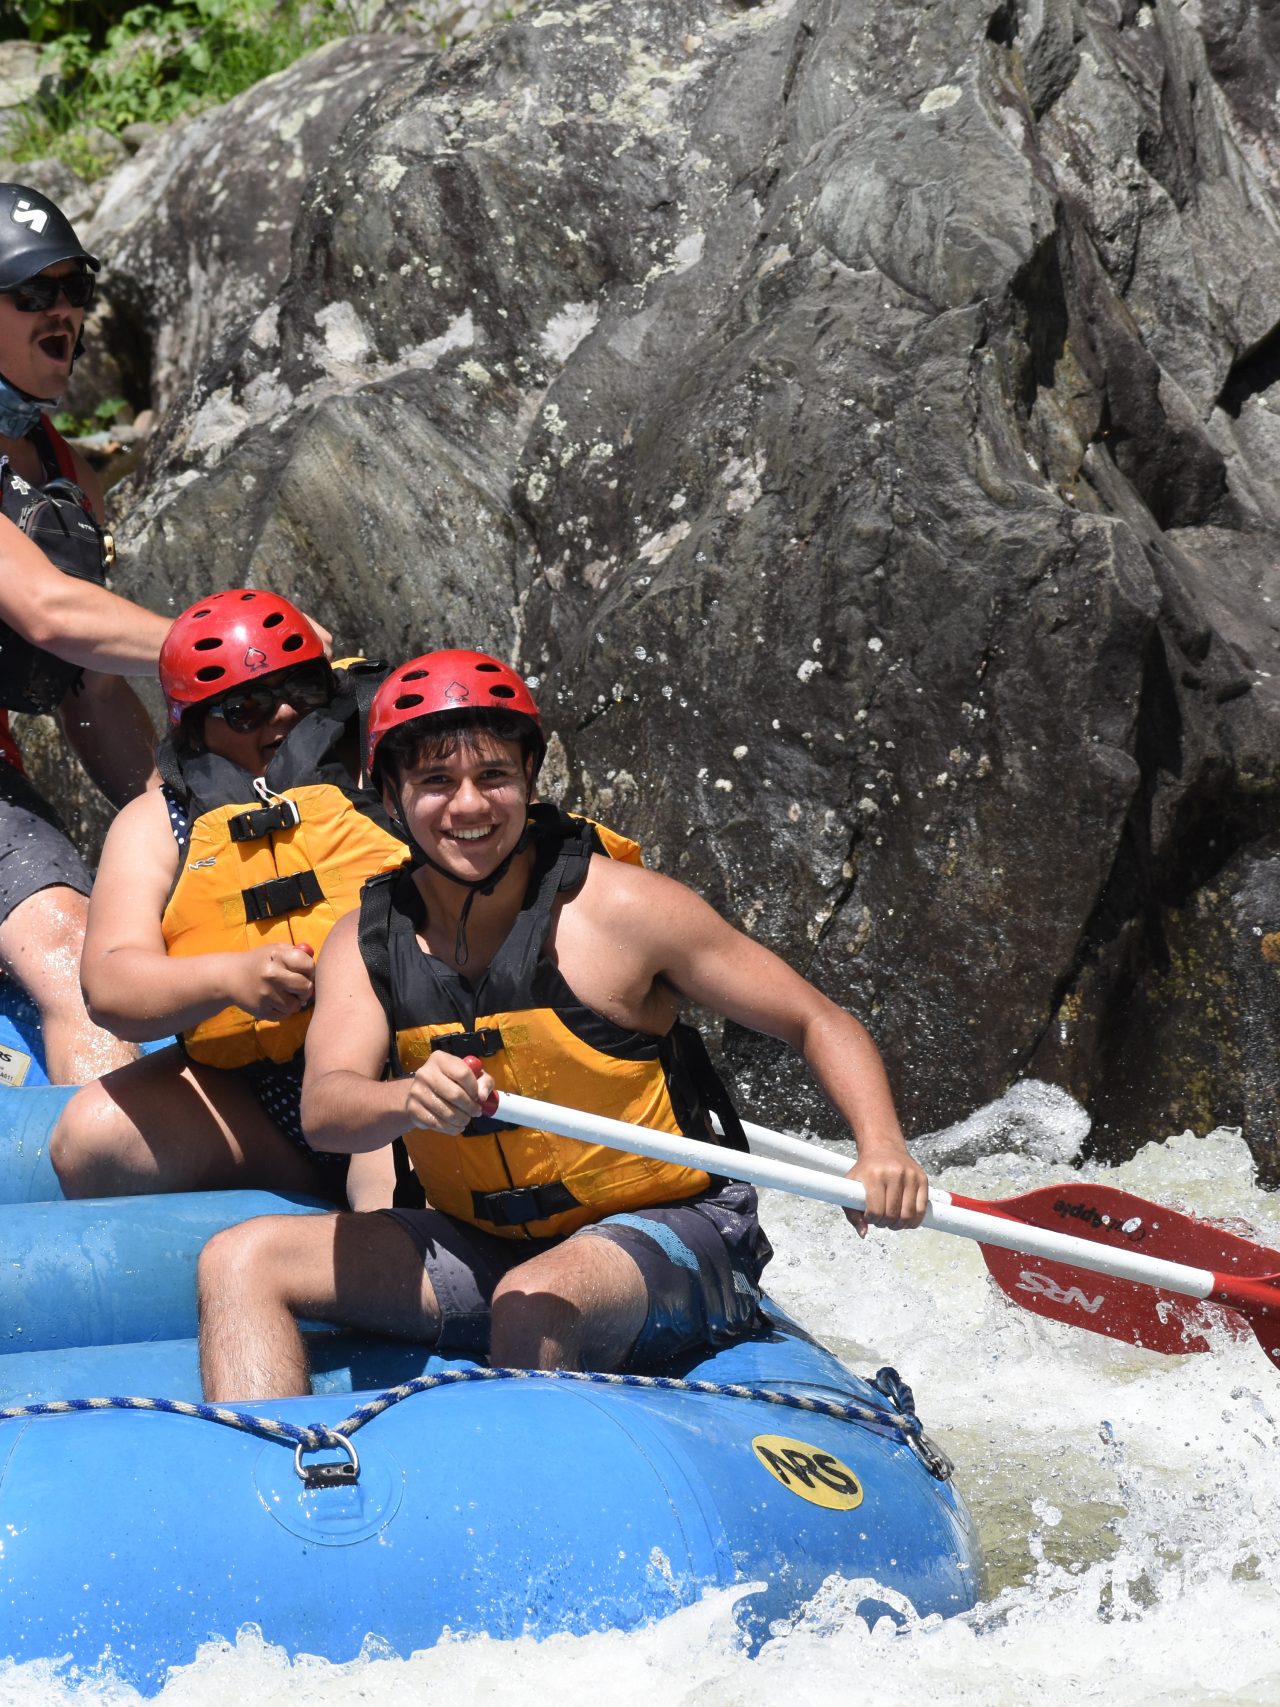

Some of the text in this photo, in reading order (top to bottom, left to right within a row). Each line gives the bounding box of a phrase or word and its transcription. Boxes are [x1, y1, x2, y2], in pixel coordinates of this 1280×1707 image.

[187, 856, 217, 872] NRS
[1014, 1271, 1105, 1313] NRS
[756, 1446, 858, 1494] NRS
